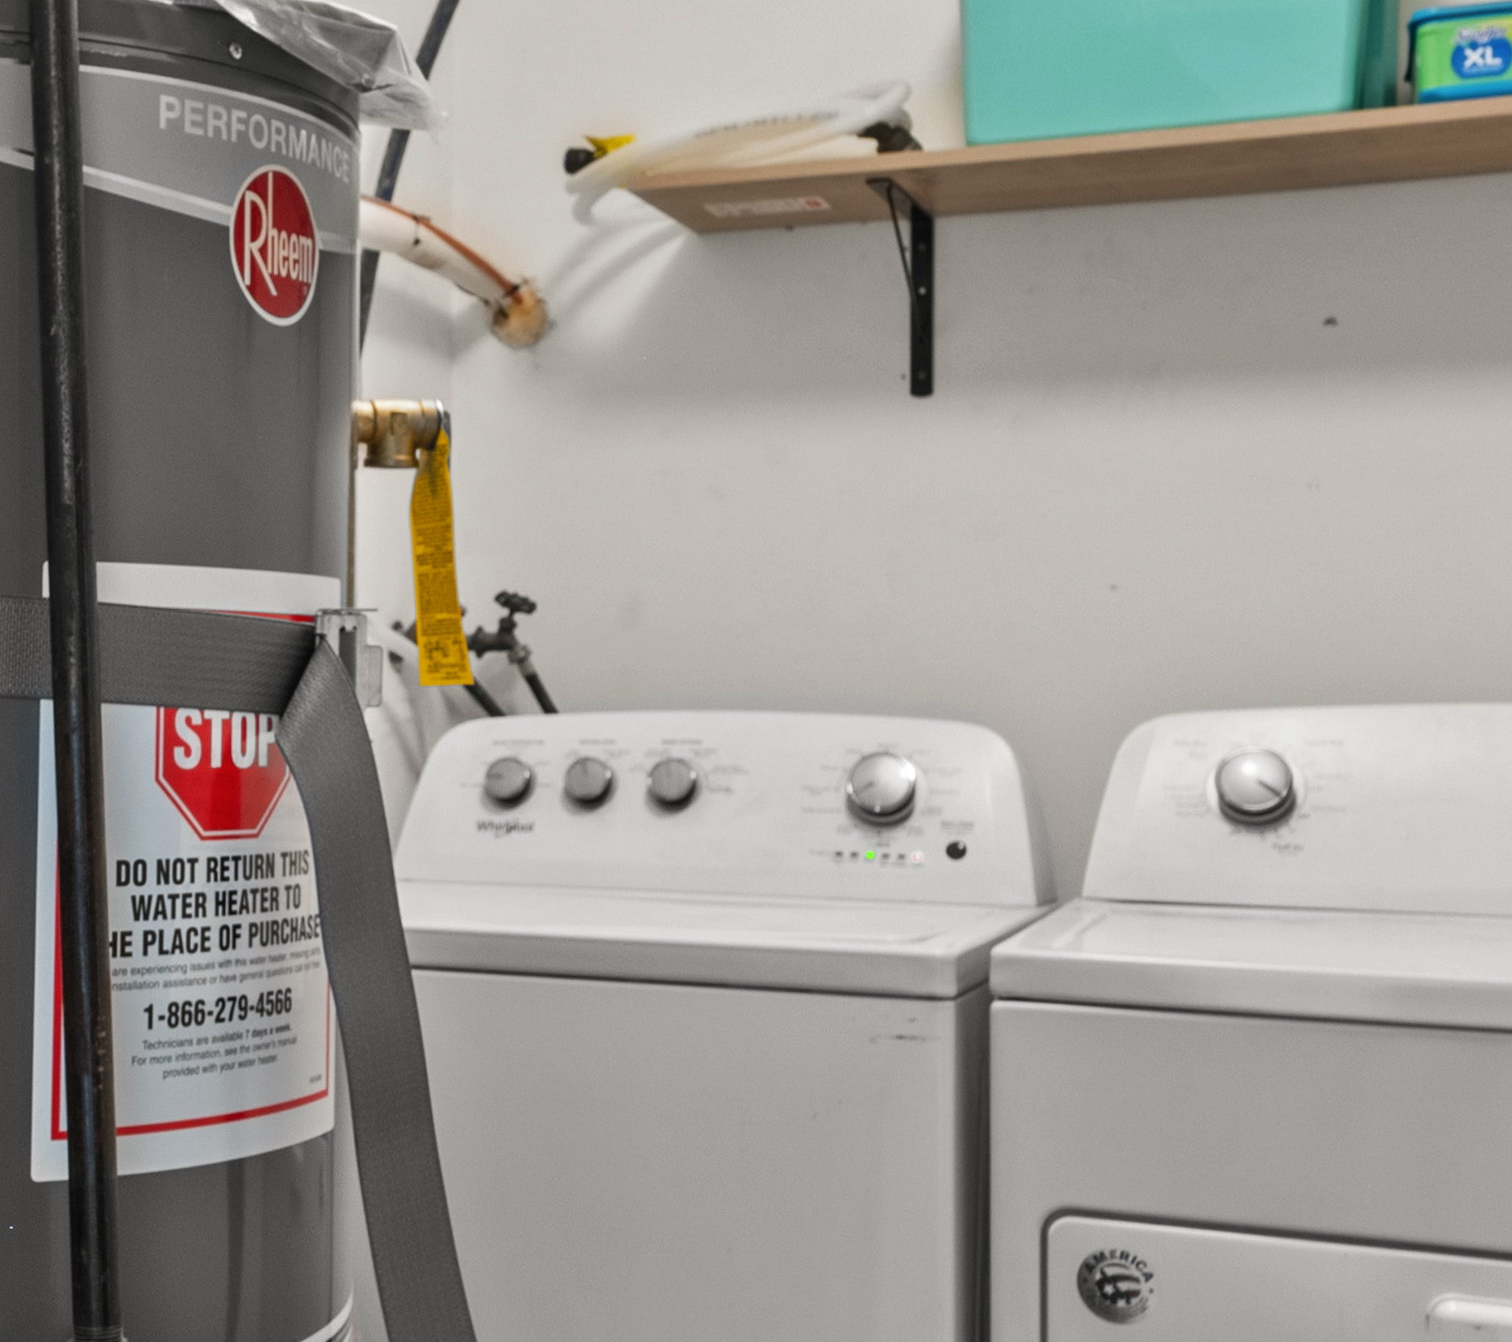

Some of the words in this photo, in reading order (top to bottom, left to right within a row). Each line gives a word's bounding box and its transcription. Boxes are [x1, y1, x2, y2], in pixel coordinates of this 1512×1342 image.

[1464, 46, 1502, 69] XL
[158, 94, 353, 182] PERFORMANCE
[243, 171, 313, 297] Rheem
[174, 708, 278, 769] STOP
[115, 858, 147, 887] DO
[156, 857, 199, 885] NOT
[206, 853, 275, 883] RETURN
[281, 849, 309, 877] THIS
[131, 892, 207, 921] WATER
[214, 885, 279, 917] HEATER
[284, 883, 301, 910] TO
[108, 930, 133, 958] HE
[142, 926, 211, 957] PLACE
[218, 923, 242, 952] OF
[248, 914, 320, 948] PURCHASE
[112, 977, 160, 993] nstallation
[130, 962, 188, 978] experiencing
[143, 987, 292, 1030] 1-866-279-4566
[131, 1055, 147, 1068] For
[149, 1053, 172, 1066] more
[224, 1046, 237, 1057] see
[239, 1043, 251, 1055] the
[142, 1038, 194, 1052] Technicians
[195, 1035, 209, 1046] are
[211, 1030, 243, 1045] available
[251, 1027, 268, 1040] days
[162, 1065, 199, 1080] provided
[202, 1062, 218, 1074] with
[220, 1060, 236, 1073] your
[1084, 1250, 1154, 1284] AMERICA
